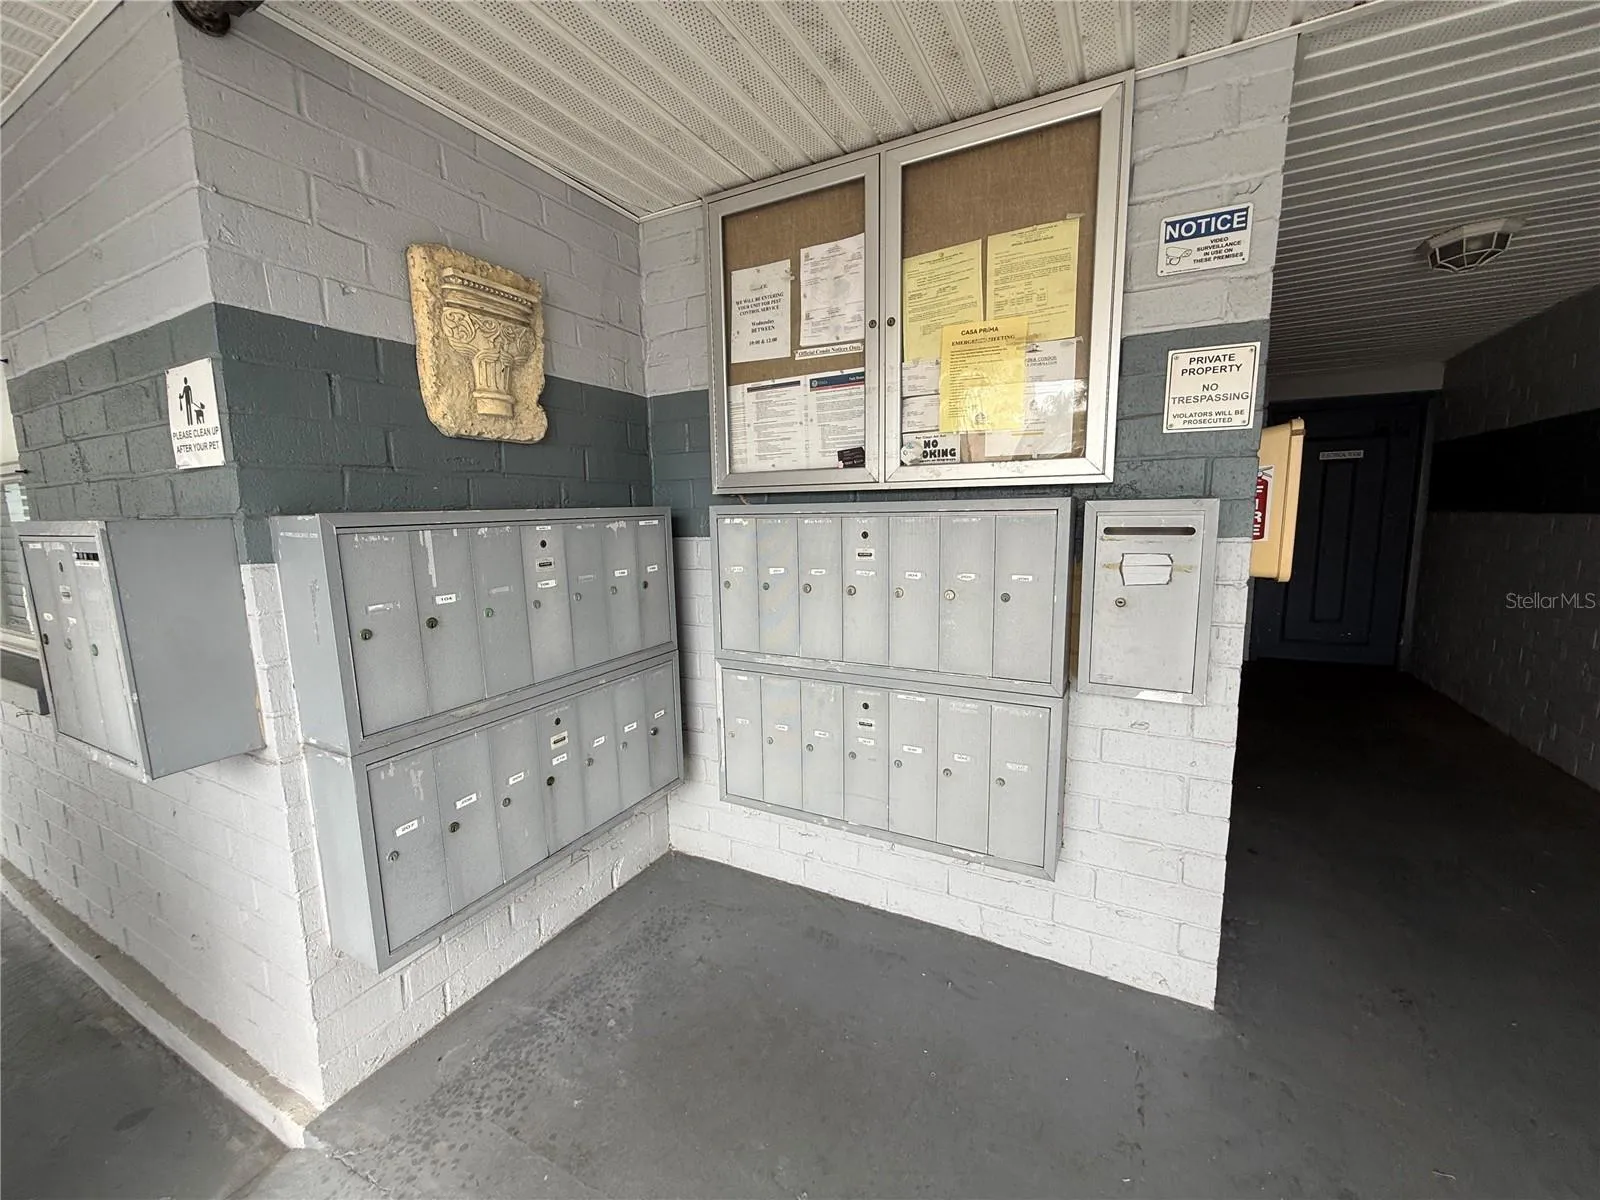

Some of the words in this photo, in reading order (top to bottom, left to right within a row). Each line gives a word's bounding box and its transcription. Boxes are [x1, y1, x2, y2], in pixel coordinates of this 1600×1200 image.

[1166, 211, 1247, 240] NOTICE
[1196, 240, 1242, 252] SURVEILLANCE
[1210, 236, 1229, 244] VIDEO
[1193, 256, 1212, 264] THESE
[1213, 252, 1244, 262] PREMISES
[761, 291, 784, 301] ENTERING
[961, 328, 978, 336] CASA
[978, 326, 999, 334] PRIMA
[951, 337, 987, 346] EMERGE
[1189, 353, 1236, 365] PRIVATE
[1181, 363, 1243, 377] PROPERTY
[1202, 383, 1219, 392] NO
[1171, 391, 1250, 405] TRESPASSING
[1172, 411, 1213, 420] VIOLATORS
[1234, 408, 1245, 416] BE
[1182, 417, 1233, 425] PROSECUTED
[172, 429, 192, 440] PLEASE
[193, 427, 211, 439] CLEAN
[211, 426, 219, 436] UP
[176, 444, 192, 454] AFTER
[193, 441, 209, 453] YOUR
[209, 440, 220, 450] PET
[923, 439, 939, 449] NO
[922, 447, 957, 459] OKING
